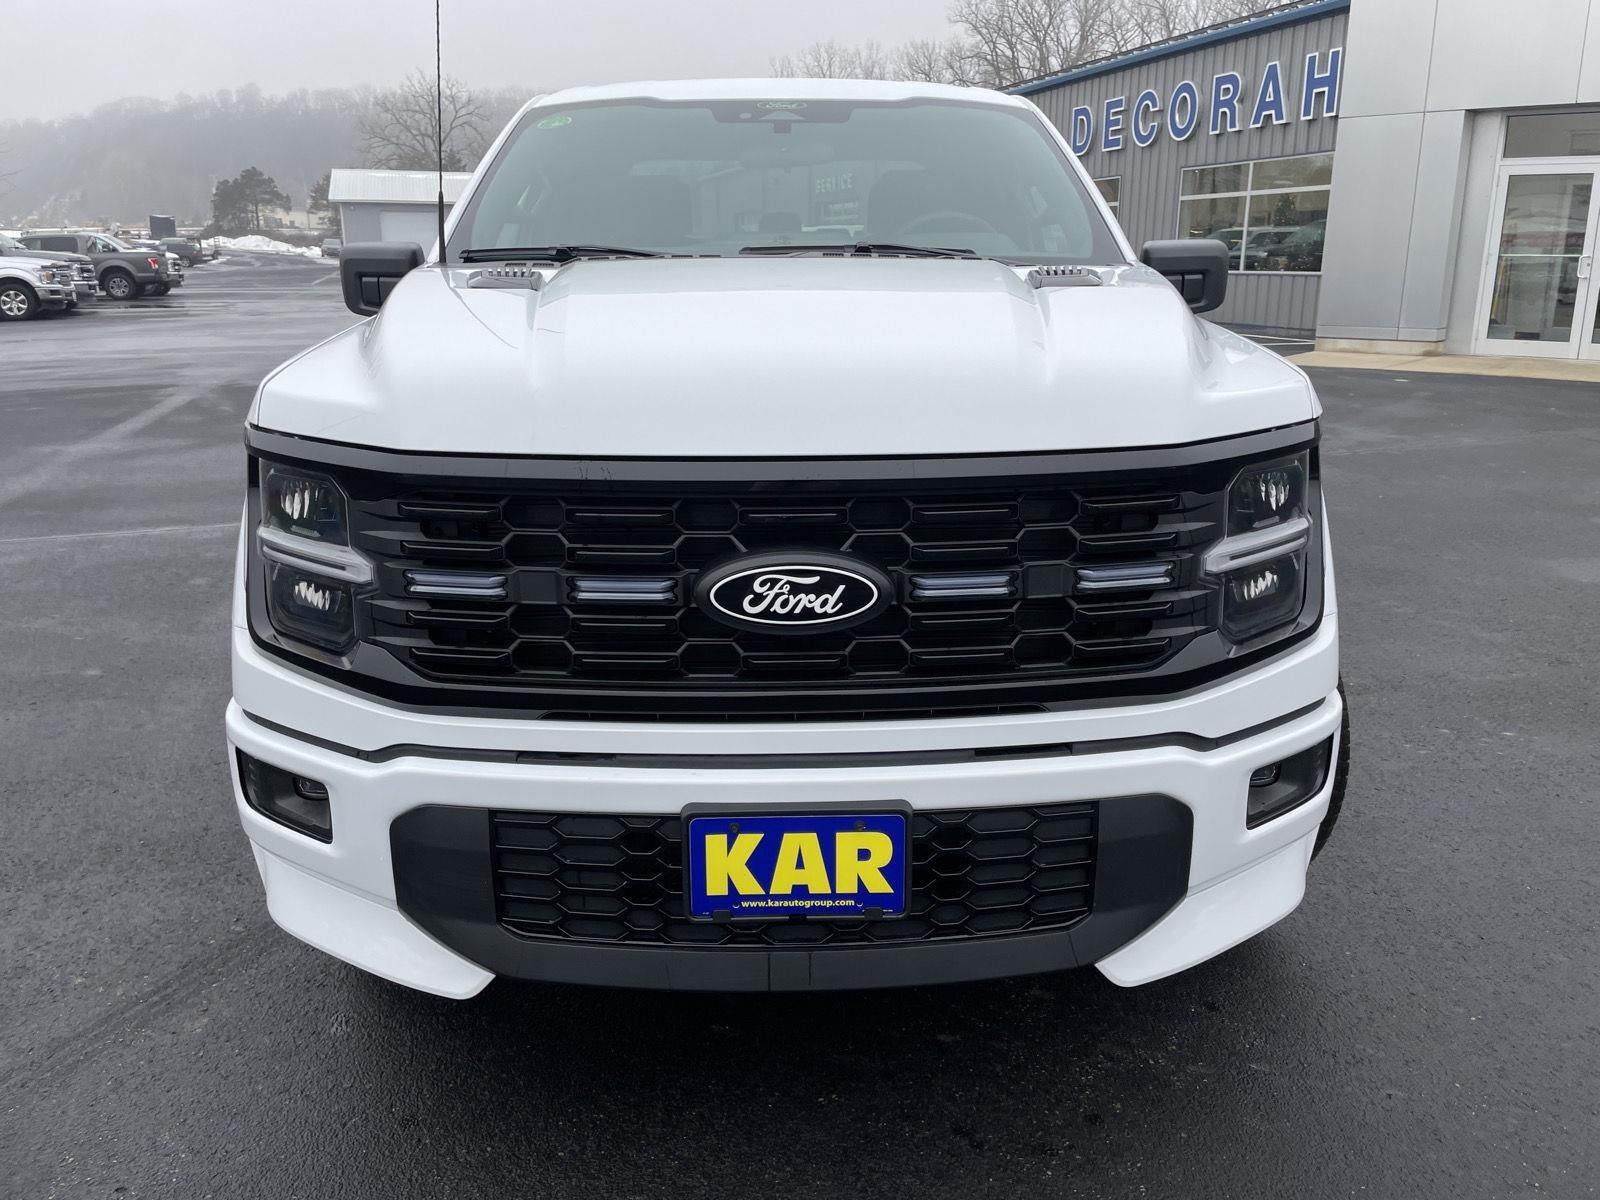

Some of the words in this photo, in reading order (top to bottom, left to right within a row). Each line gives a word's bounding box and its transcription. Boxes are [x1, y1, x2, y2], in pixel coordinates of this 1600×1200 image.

[1072, 47, 1342, 156] DECORAH
[742, 574, 846, 614] Ford
[705, 831, 895, 897] KAR
[741, 899, 855, 908] www.karautogroup.com
